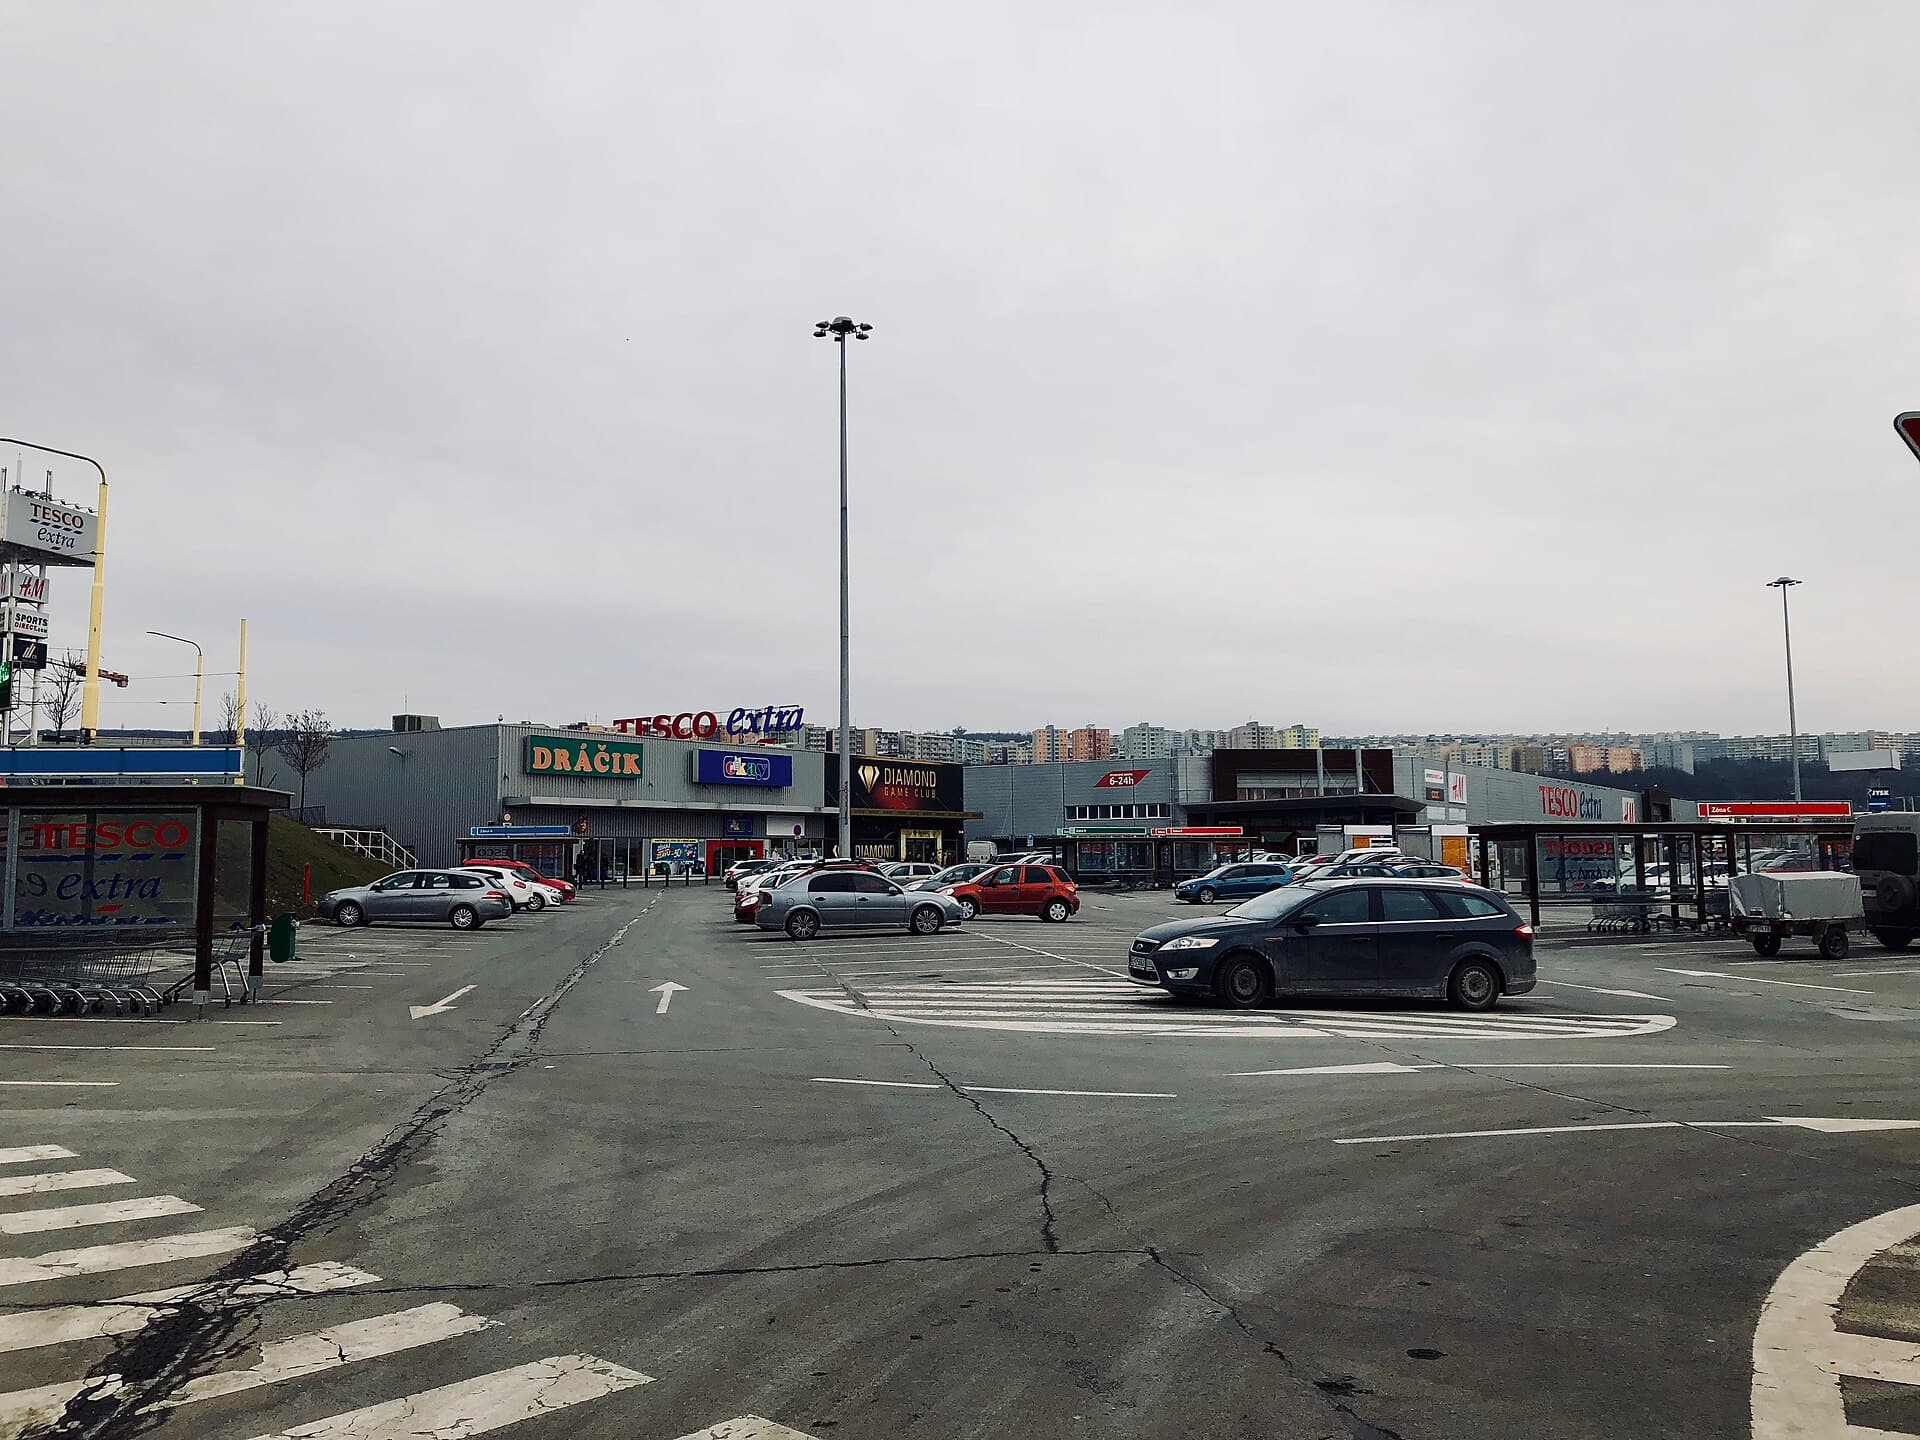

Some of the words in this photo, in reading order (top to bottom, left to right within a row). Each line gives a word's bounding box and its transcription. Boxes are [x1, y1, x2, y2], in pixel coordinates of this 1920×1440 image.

[30, 502, 84, 529] TESCO
[37, 527, 75, 548] extra
[15, 612, 48, 626] SPORTS
[612, 711, 719, 739] TESCO
[726, 705, 805, 736] extra
[532, 742, 641, 775] DRÁČIK
[884, 767, 937, 788] DIAMOND
[1109, 776, 1134, 786] 6-24h
[884, 786, 909, 797] GAME
[914, 788, 937, 799] CLUB
[1538, 785, 1578, 817] TESCO
[1579, 791, 1602, 820] extra
[33, 821, 189, 849] TESCO
[855, 844, 895, 859] DIAMOND
[56, 872, 162, 900] extra
